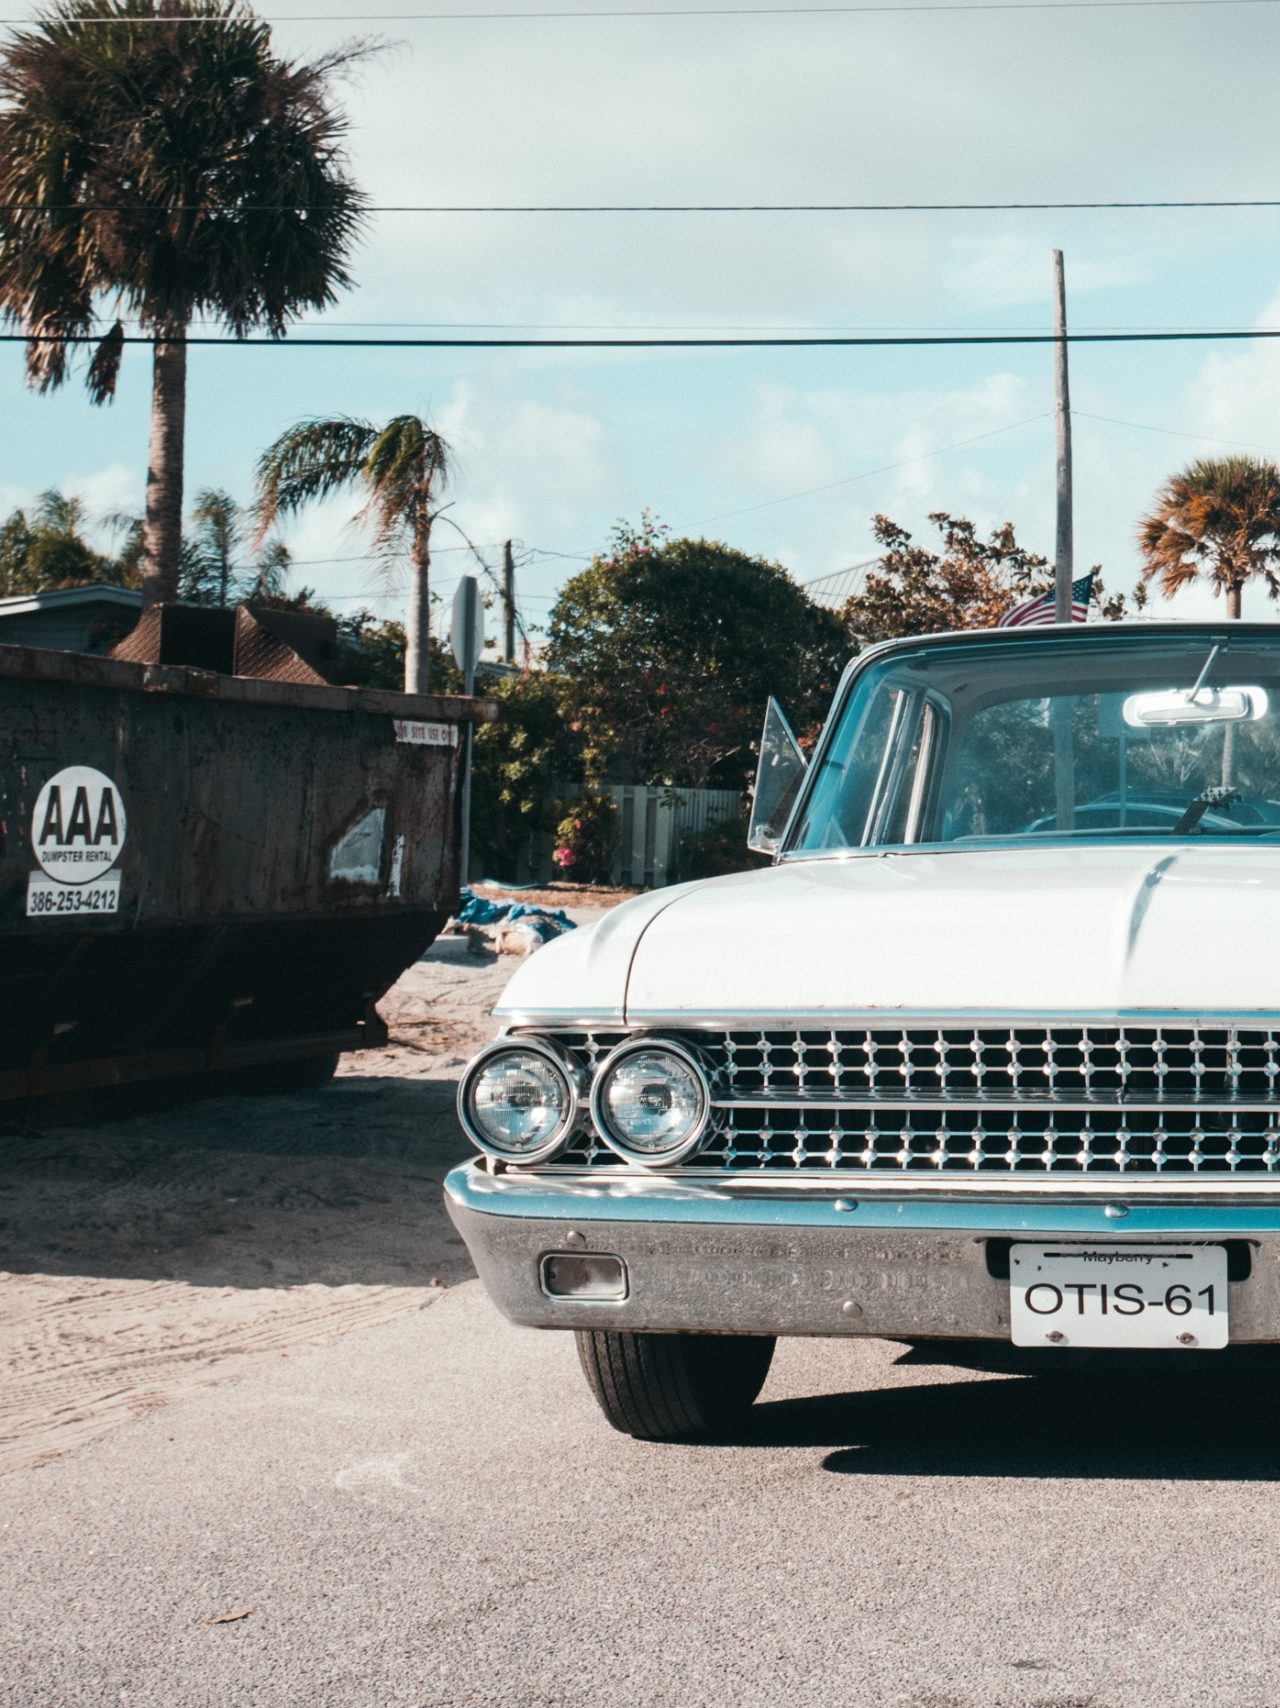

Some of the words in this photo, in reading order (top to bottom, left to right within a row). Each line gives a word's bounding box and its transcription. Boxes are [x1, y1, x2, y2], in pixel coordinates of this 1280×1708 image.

[38, 785, 118, 846] AAA
[42, 850, 83, 863] DUMPSTER
[85, 850, 113, 862] RENTAL
[30, 889, 116, 913] 386-253-4212
[1083, 1251, 1154, 1265] Mayberry
[1024, 1282, 1215, 1316] OTIS-61
